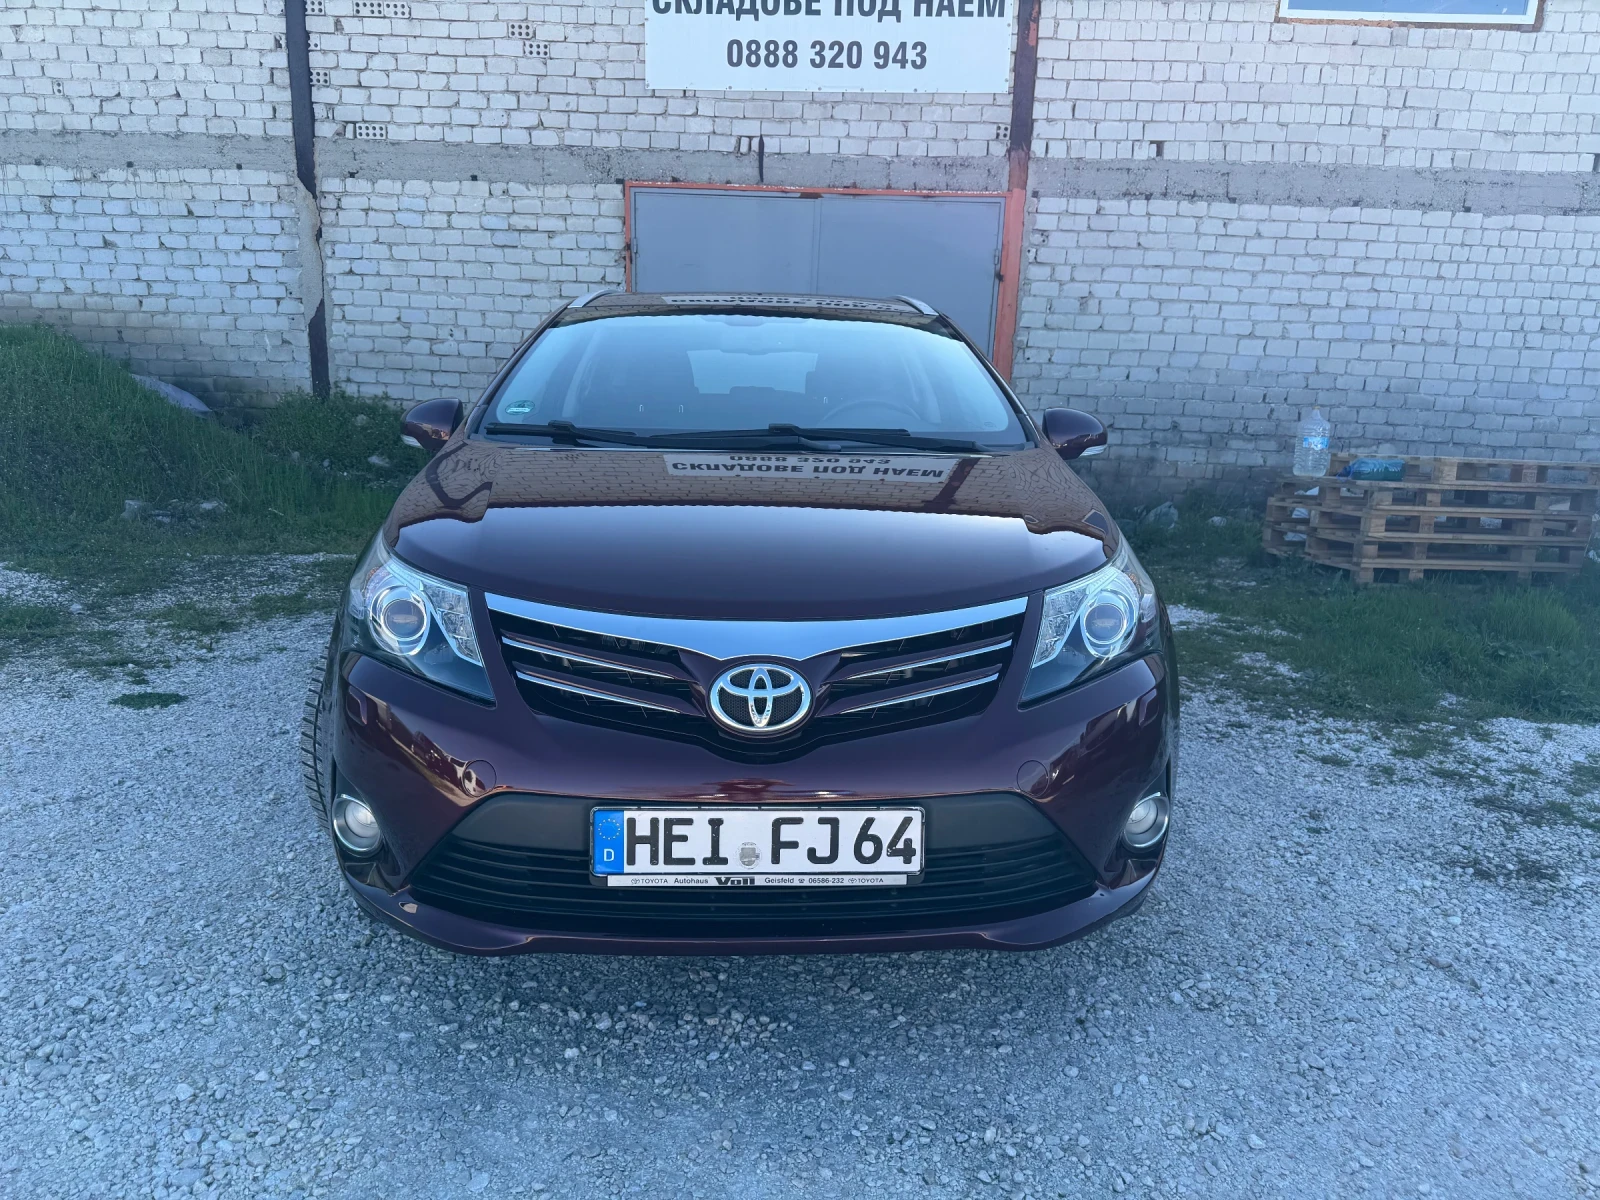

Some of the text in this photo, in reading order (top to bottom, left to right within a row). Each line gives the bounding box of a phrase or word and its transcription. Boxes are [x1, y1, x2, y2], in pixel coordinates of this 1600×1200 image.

[726, 39, 927, 70] 0888 320 943
[626, 817, 729, 866] HEI
[603, 849, 615, 862] D
[673, 876, 709, 884] Autohaus
